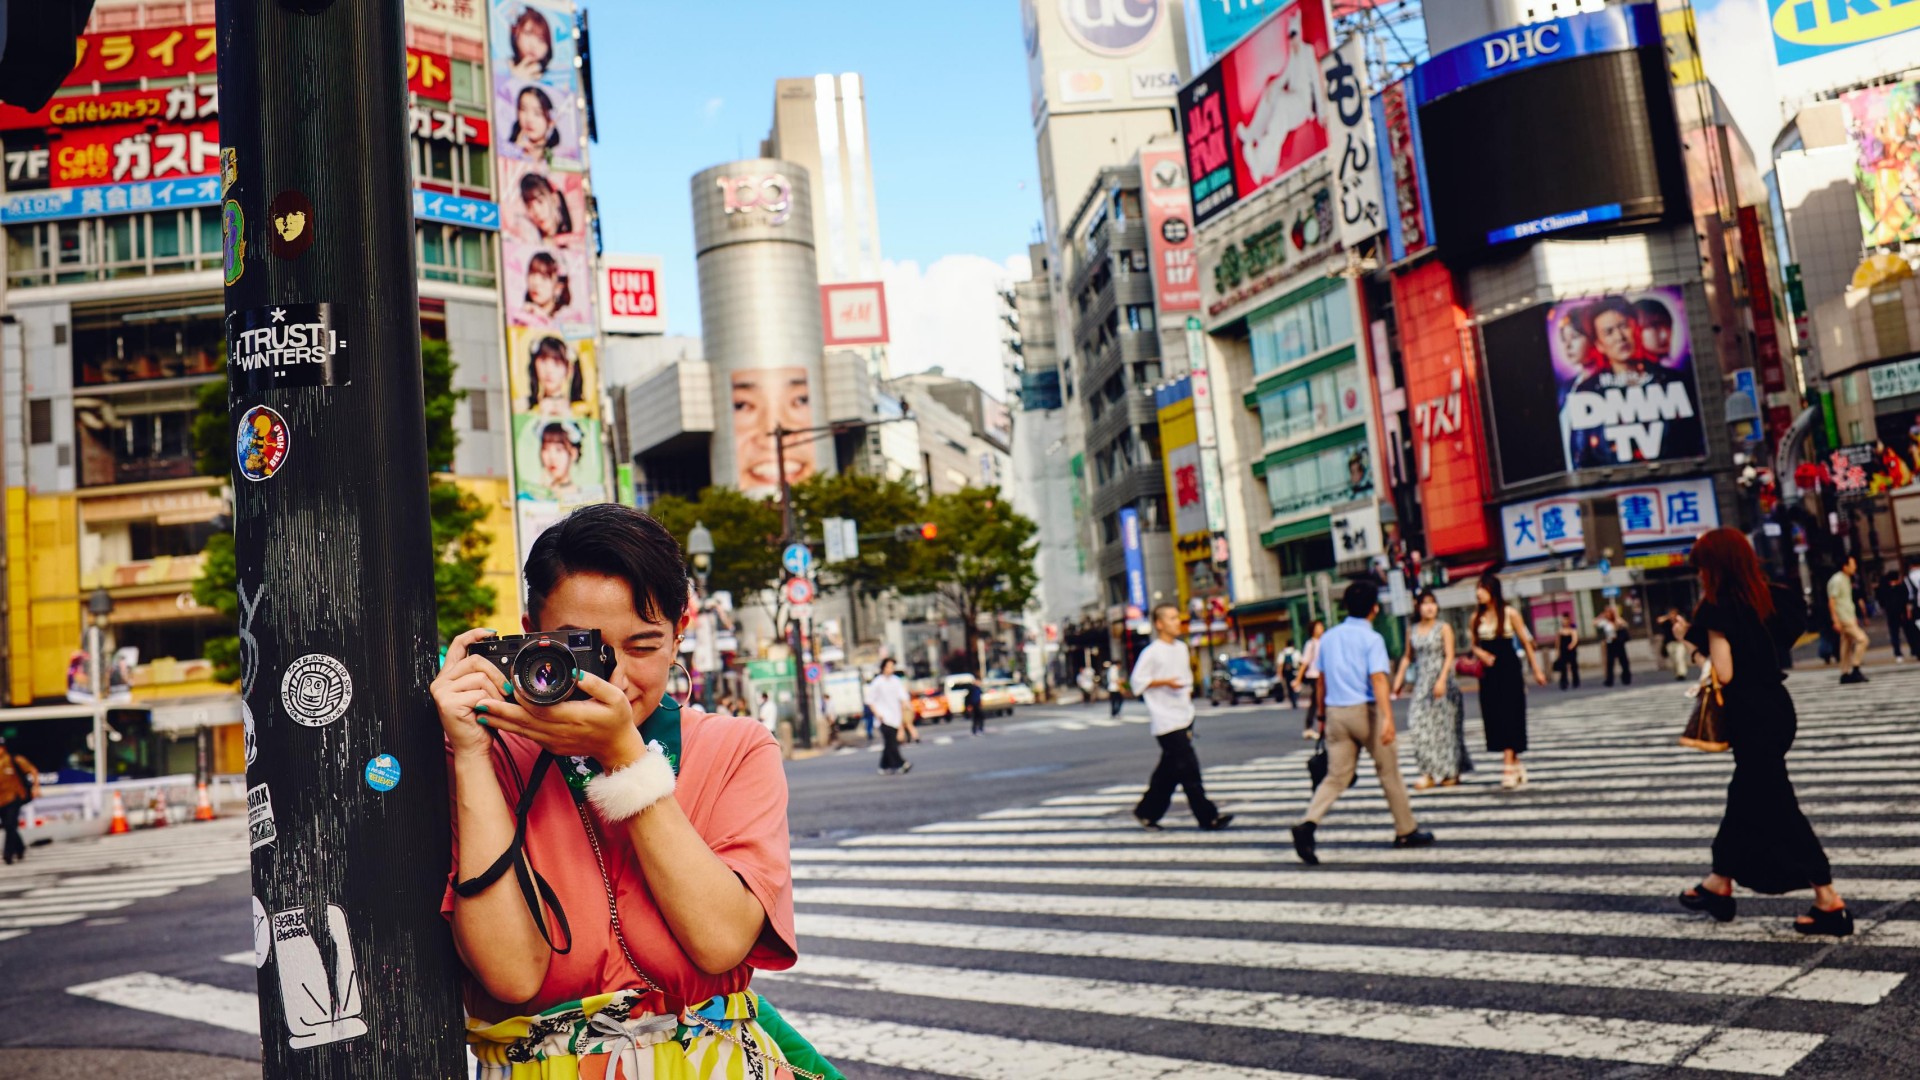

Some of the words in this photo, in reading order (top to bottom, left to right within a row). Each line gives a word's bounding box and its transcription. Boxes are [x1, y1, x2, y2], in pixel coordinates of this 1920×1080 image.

[1794, 0, 1920, 33] IK
[1483, 24, 1560, 68] DHC
[1137, 73, 1180, 89] VISA
[1326, 51, 1379, 227] もんじゃ
[5, 150, 49, 180] 7F
[112, 132, 219, 181] ガスト
[716, 174, 793, 226] 109
[611, 271, 649, 291] UNI
[613, 294, 655, 315] QLO
[241, 324, 325, 354] TRUST
[242, 346, 327, 371] WINTERS
[1567, 381, 1694, 431] DMM
[269, 449, 283, 467] BEE
[1604, 421, 1664, 462] TV
[1514, 491, 1699, 546] 大盛書店
